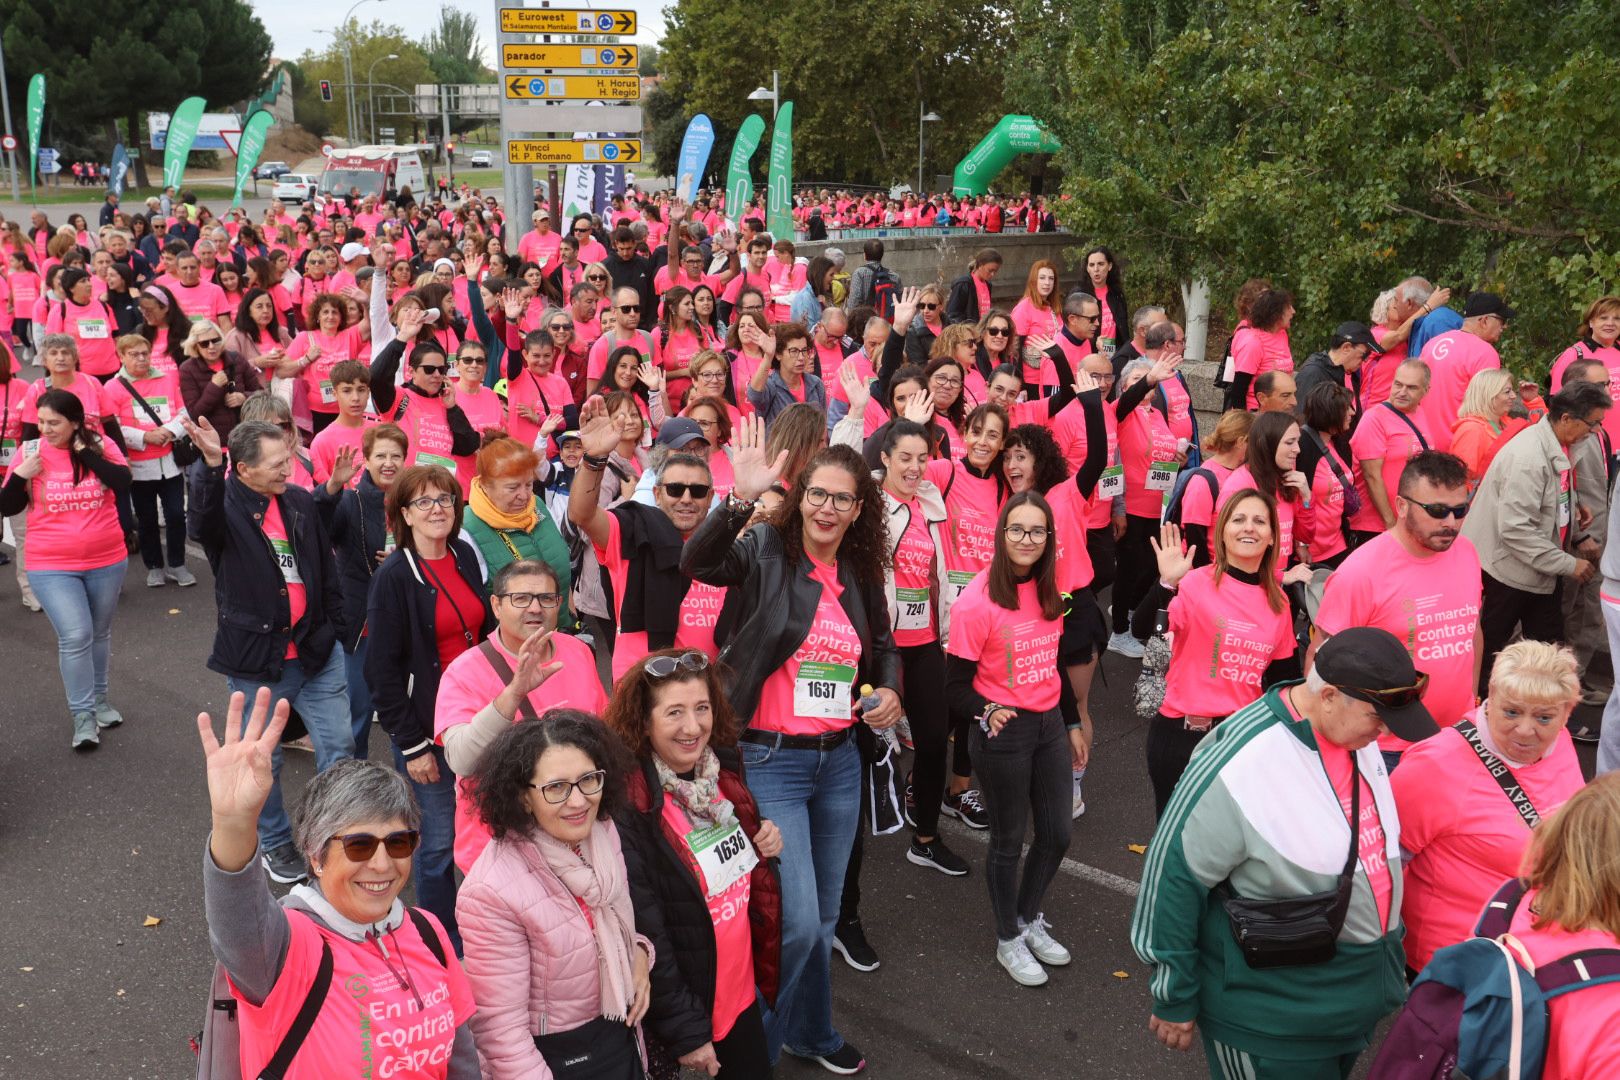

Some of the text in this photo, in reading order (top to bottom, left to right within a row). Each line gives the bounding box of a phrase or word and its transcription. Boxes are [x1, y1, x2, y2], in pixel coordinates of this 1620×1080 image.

[518, 13, 565, 21] Eurowest
[506, 52, 546, 61] parador
[613, 89, 637, 97] Regio
[605, 165, 615, 202] HYU
[46, 481, 60, 489] En
[1151, 472, 1170, 481] 3986
[46, 490, 91, 501] contra
[48, 499, 104, 513] cáncer
[683, 610, 717, 627] cán
[906, 603, 925, 615] 7247
[1417, 603, 1478, 626] En marcha
[820, 620, 856, 635] marc
[1418, 618, 1477, 642] contra el
[807, 633, 852, 652] ontra
[1015, 640, 1029, 652] En
[1224, 633, 1274, 654] En marc
[1418, 639, 1473, 660] cánce
[792, 645, 857, 667] cánce
[1017, 665, 1056, 684] cánc
[808, 681, 836, 699] 1637
[1504, 785, 1541, 829] MBAY
[714, 831, 745, 864] 1636
[370, 1001, 400, 1021] En
[376, 1016, 448, 1047] contra
[379, 1038, 453, 1078] cánce
